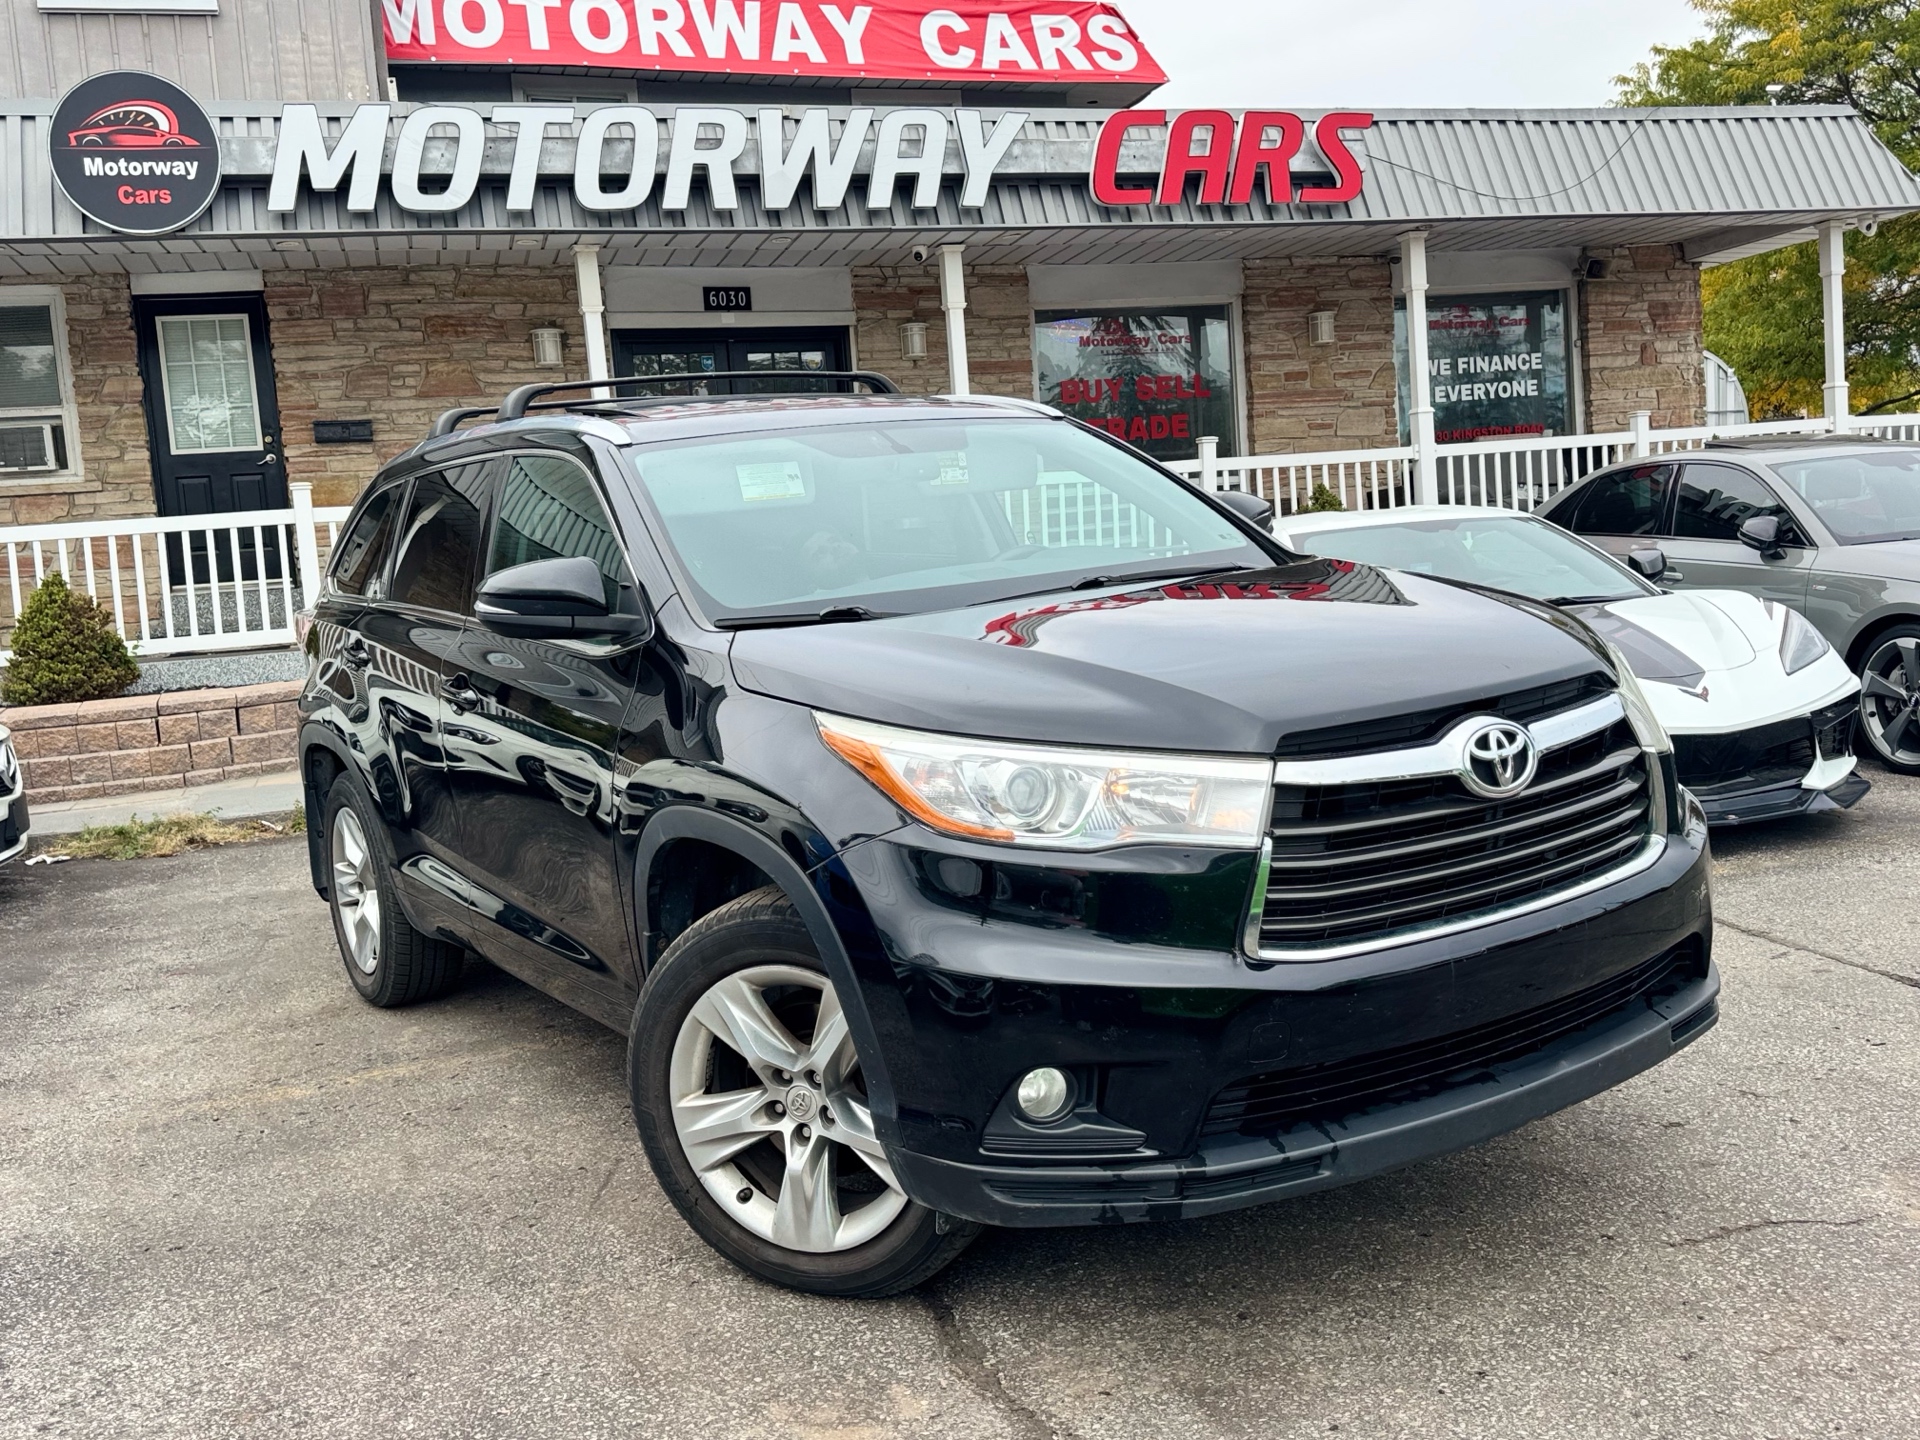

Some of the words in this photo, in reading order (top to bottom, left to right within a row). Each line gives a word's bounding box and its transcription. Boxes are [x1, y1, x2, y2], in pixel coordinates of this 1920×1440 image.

[381, 0, 872, 65] MOTORWAY
[919, 9, 1139, 72] CARS
[83, 156, 199, 181] Motorway
[267, 103, 1030, 212] MOTORWAY
[1090, 109, 1374, 207] CARS
[117, 184, 173, 205] Cars
[709, 291, 746, 307] 6030
[1429, 318, 1494, 331] Motorway
[1499, 316, 1531, 327] Cars
[1079, 334, 1151, 349] Motorway
[1158, 332, 1193, 344] Cars
[1428, 359, 1451, 376] WE
[1457, 352, 1543, 375] FINANCE
[1060, 376, 1125, 405] BUY
[1135, 372, 1212, 401] SELL
[1434, 379, 1539, 403] EVERYONE
[1436, 430, 1449, 442] 30
[1452, 425, 1511, 440] KINGSTON
[1514, 423, 1545, 435] ROAD
